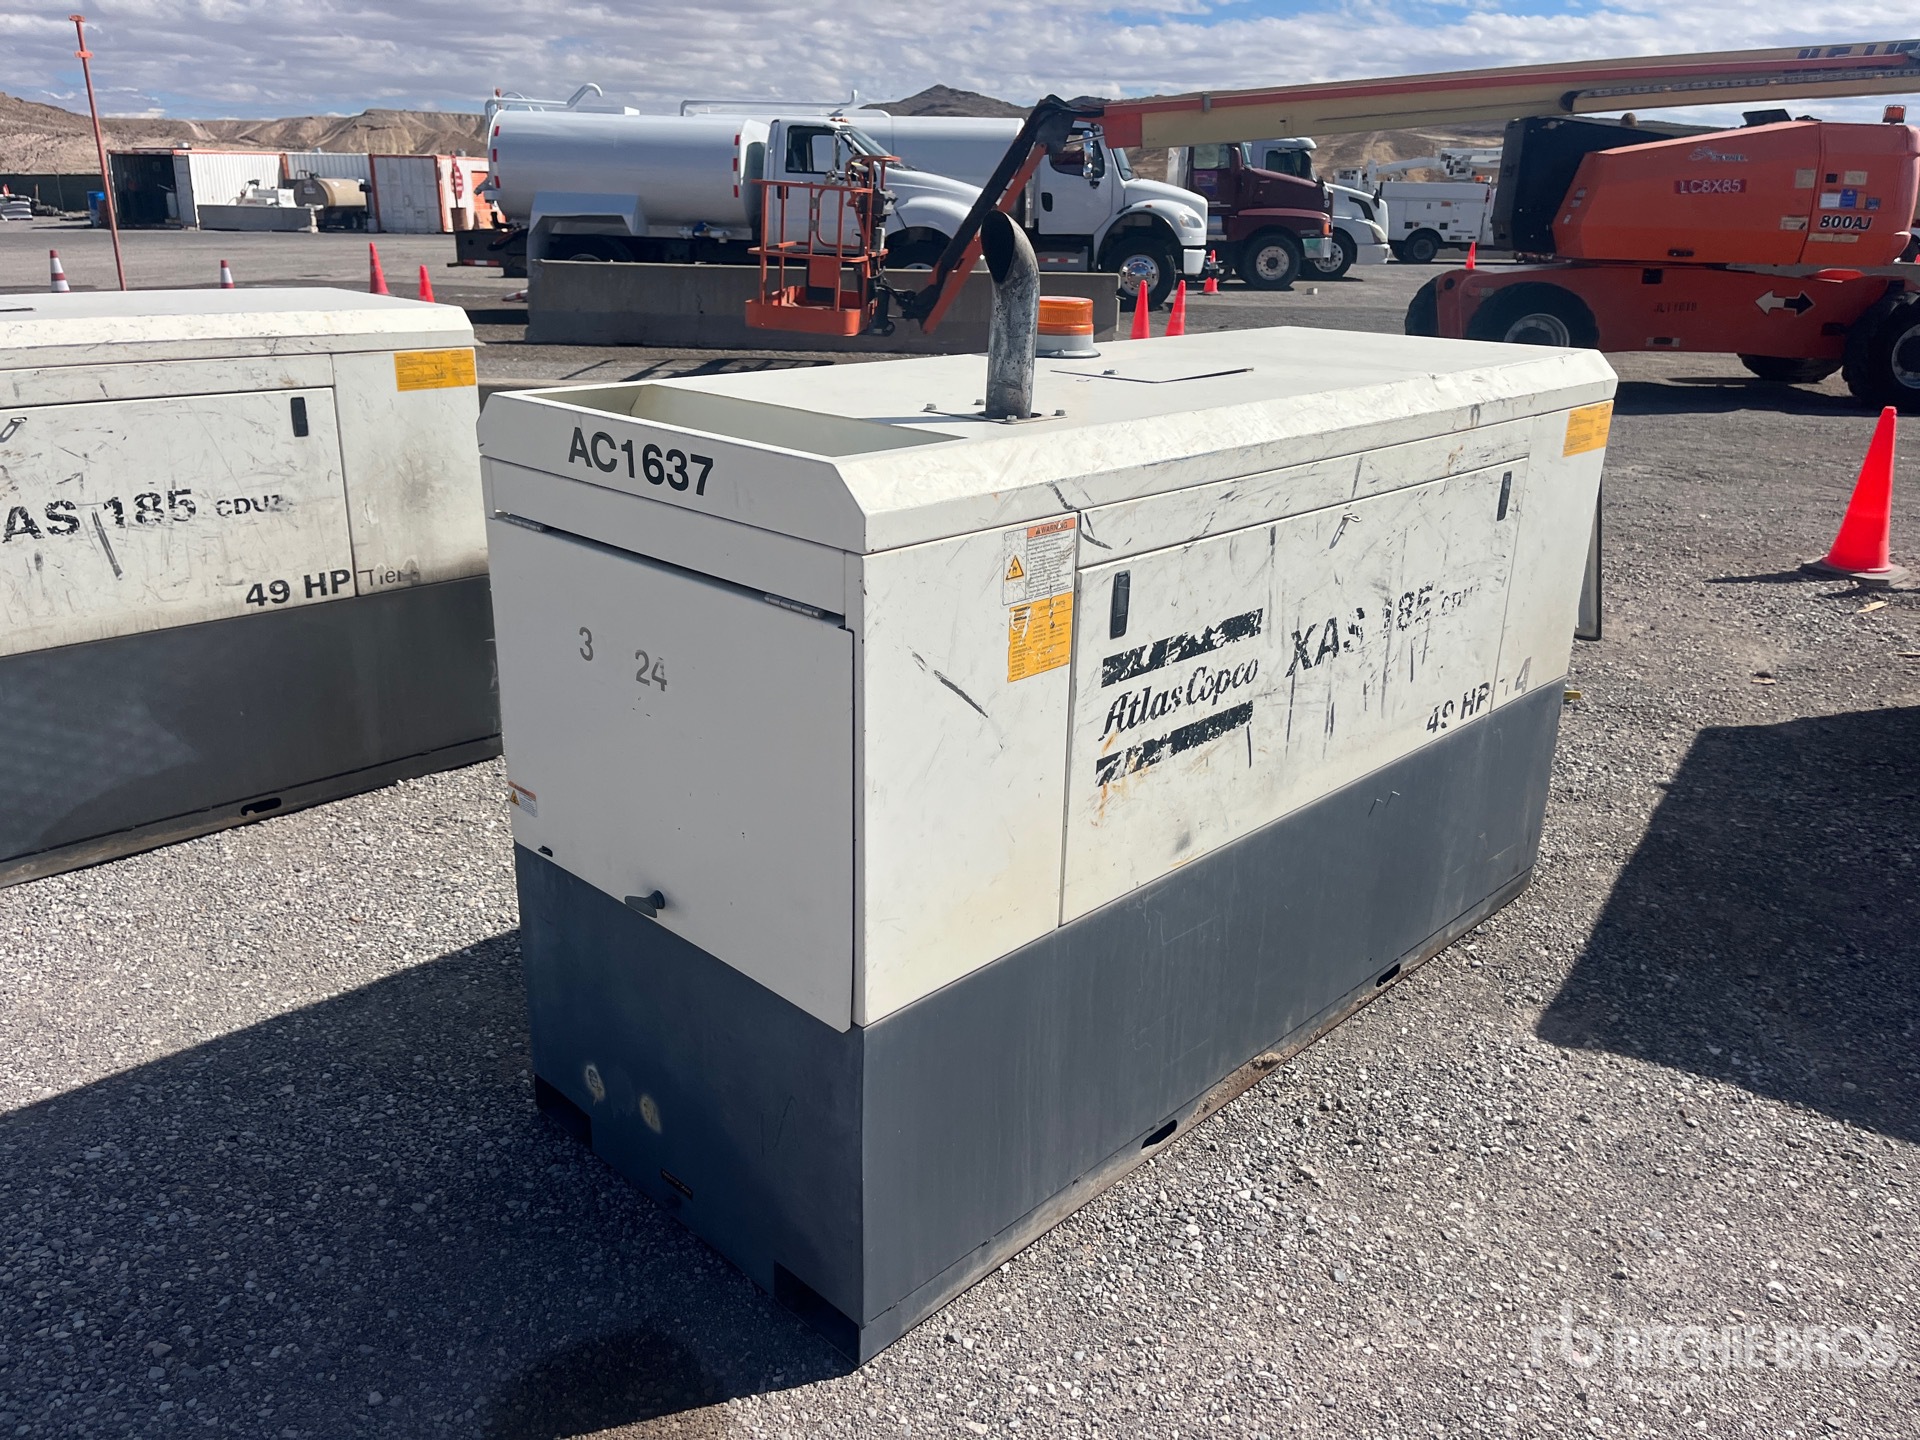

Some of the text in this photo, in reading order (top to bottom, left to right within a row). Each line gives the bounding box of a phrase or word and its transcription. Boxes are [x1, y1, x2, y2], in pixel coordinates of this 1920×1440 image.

[1680, 179, 1741, 194] LC8X85
[1819, 215, 1873, 231] 800AJ
[568, 427, 714, 496] AC1637
[102, 489, 197, 529] 185
[245, 579, 290, 608] 49
[304, 569, 351, 600] HP
[579, 627, 595, 662] 3
[1285, 607, 1365, 678] XAS
[1383, 580, 1434, 639] 185
[634, 649, 668, 692] 24
[1098, 658, 1259, 741] Atlas Copco
[1426, 699, 1455, 734] 49
[1460, 681, 1490, 720] HP
